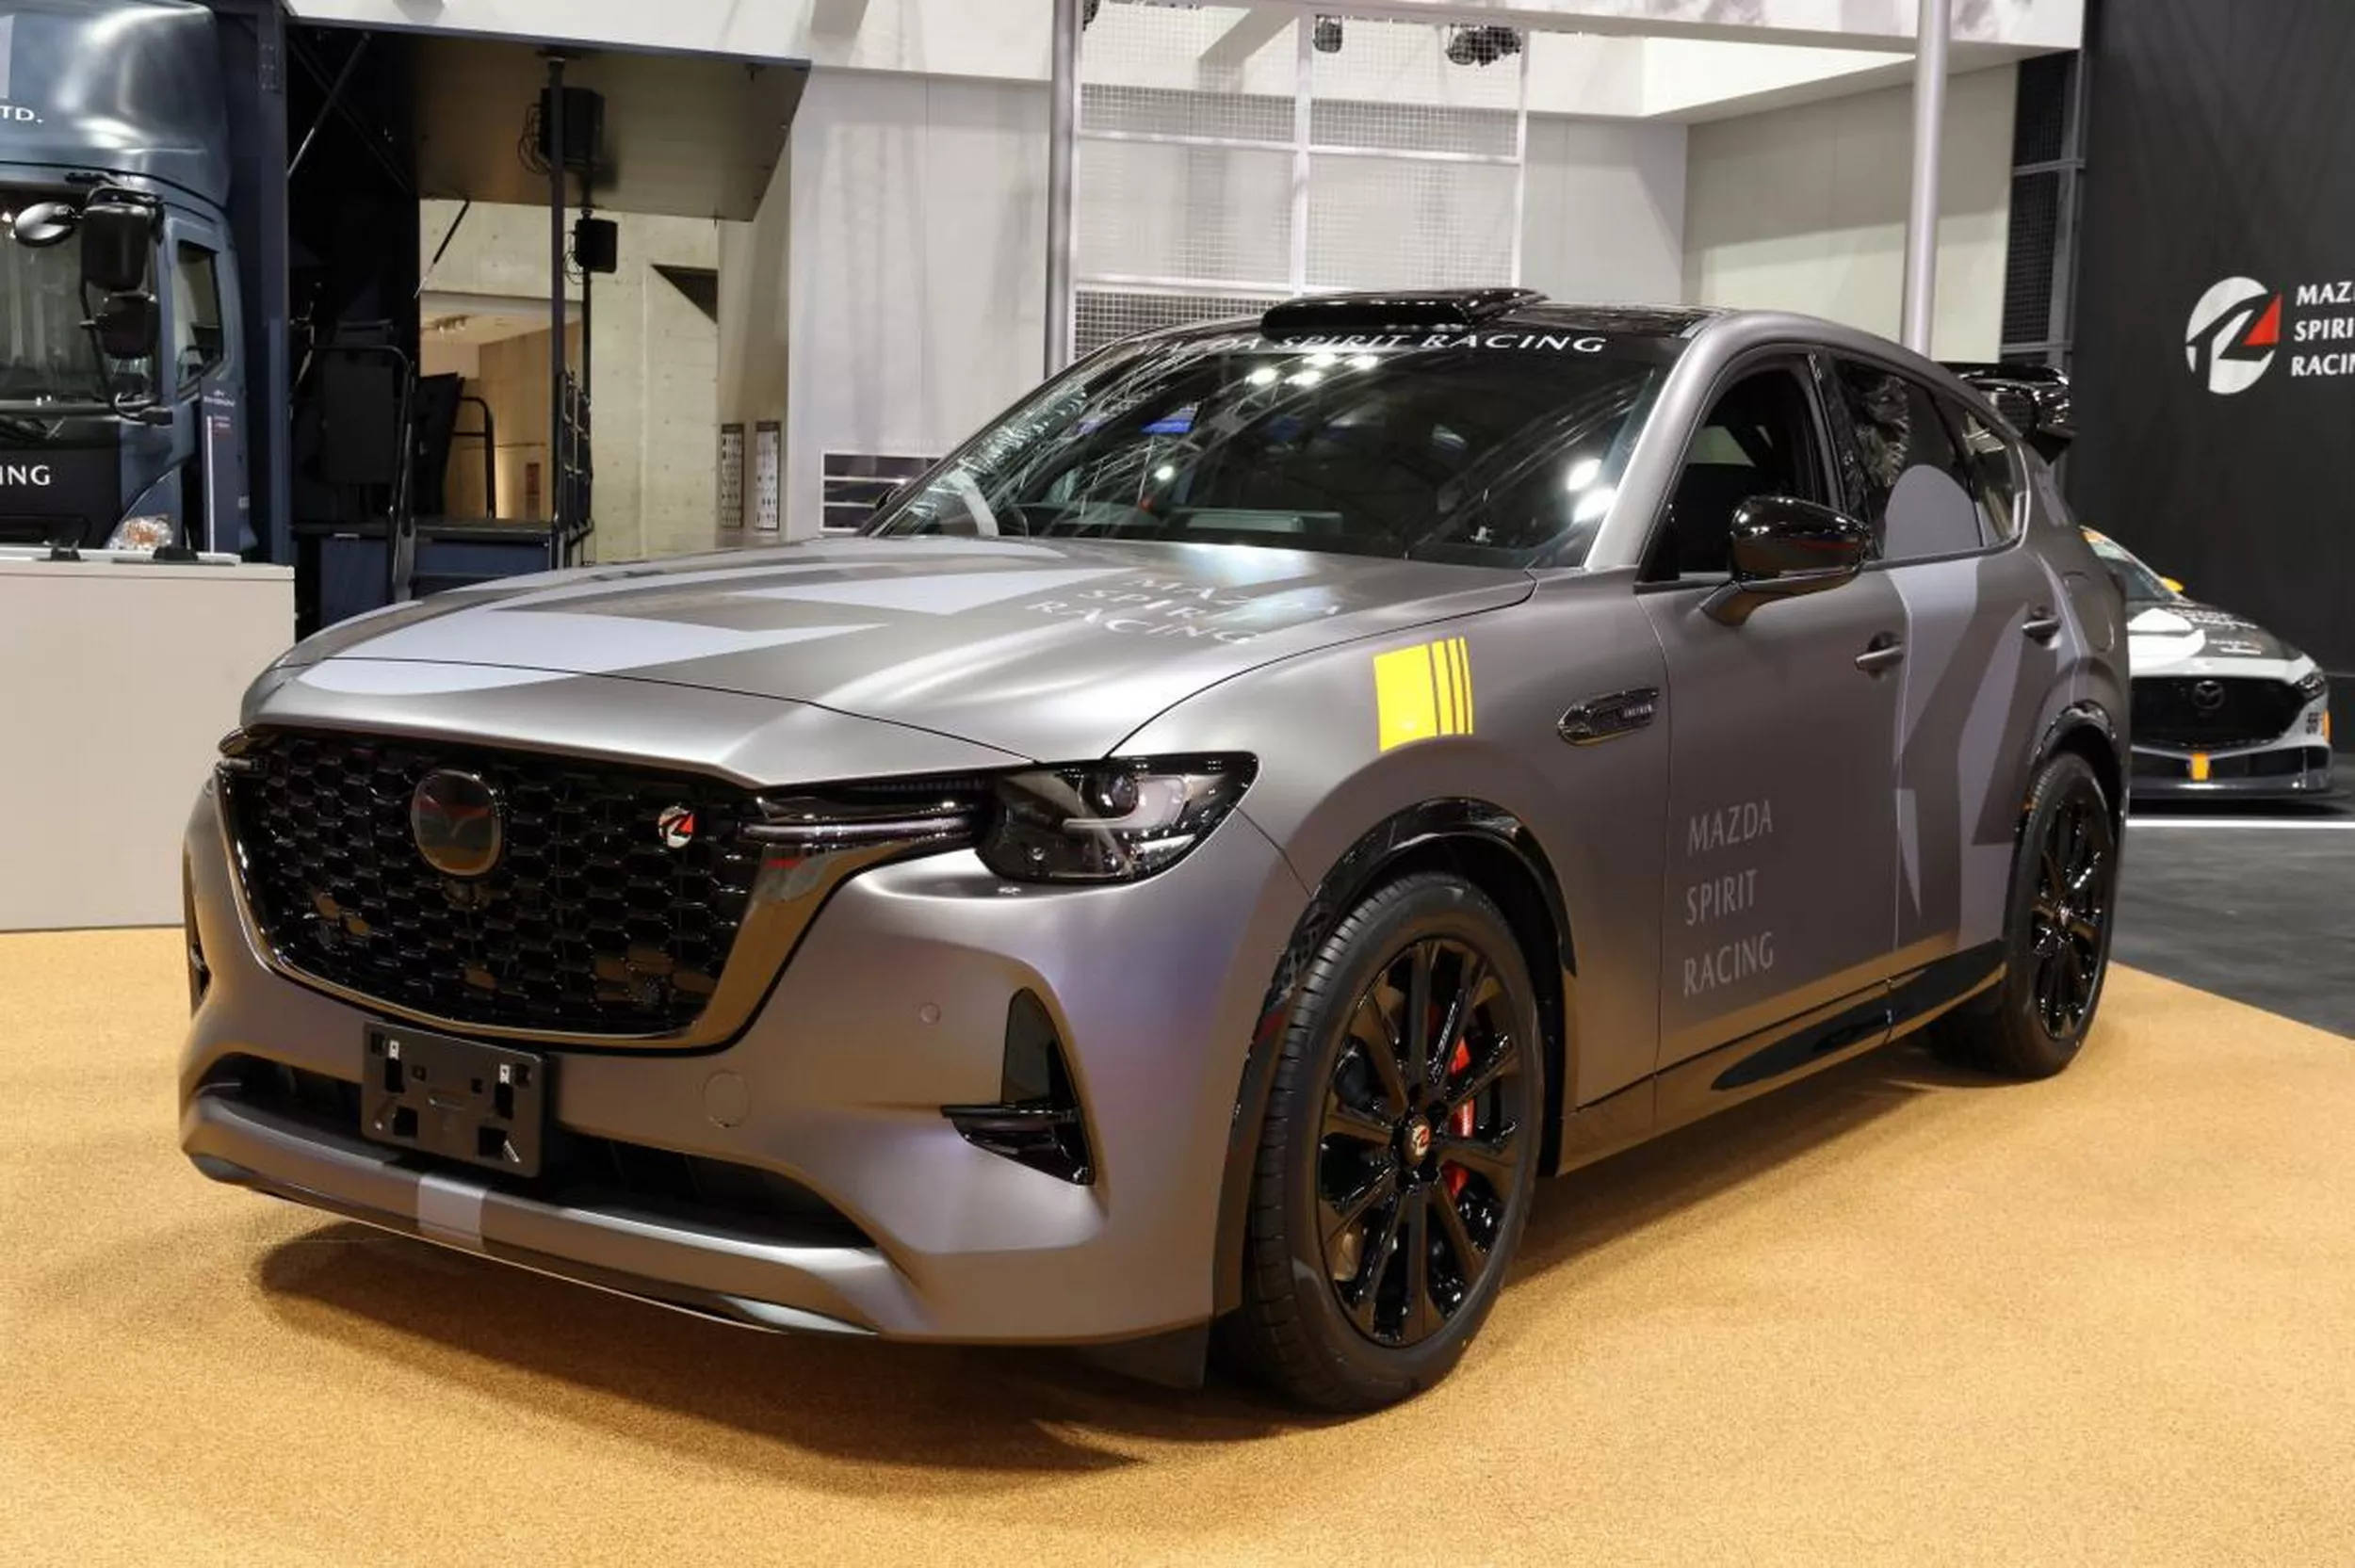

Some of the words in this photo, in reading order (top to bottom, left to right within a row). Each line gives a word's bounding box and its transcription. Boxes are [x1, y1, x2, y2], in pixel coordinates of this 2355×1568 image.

[2297, 282, 2355, 306] MAZ
[1274, 334, 1411, 351] SPIRIT
[1421, 334, 1606, 352] RACING
[1025, 601, 1259, 645] RACING
[1688, 800, 1773, 856] MAZDA
[1686, 869, 1758, 927] SPIRIT
[1683, 931, 1774, 998] RACING
